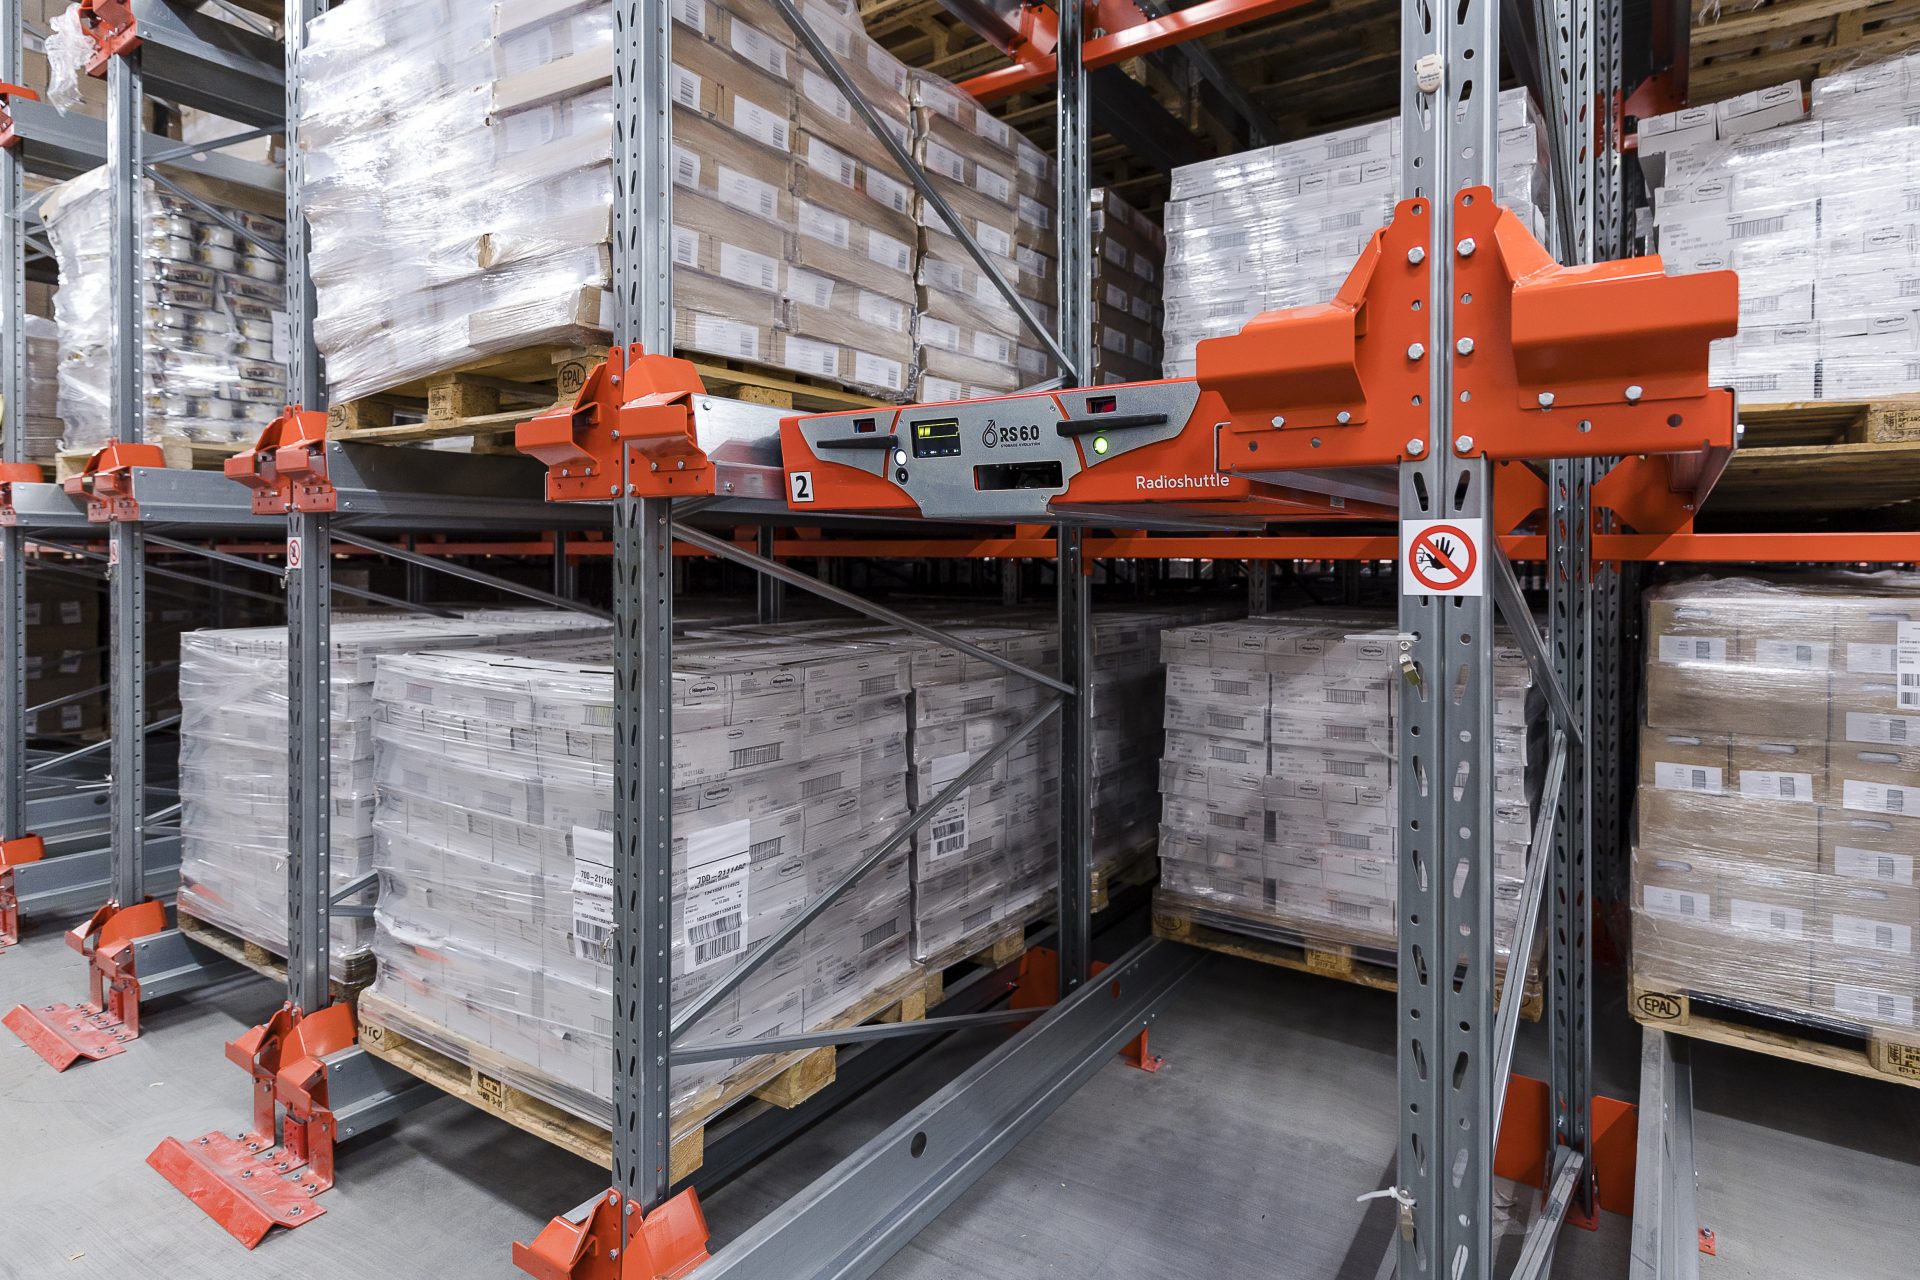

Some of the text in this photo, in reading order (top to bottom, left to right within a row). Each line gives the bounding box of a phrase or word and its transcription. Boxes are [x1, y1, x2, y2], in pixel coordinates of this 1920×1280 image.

[562, 370, 582, 388] EPAL
[796, 475, 808, 498] 2
[1135, 473, 1230, 489] Radioshuttle
[1644, 997, 1675, 1016] EPAL
